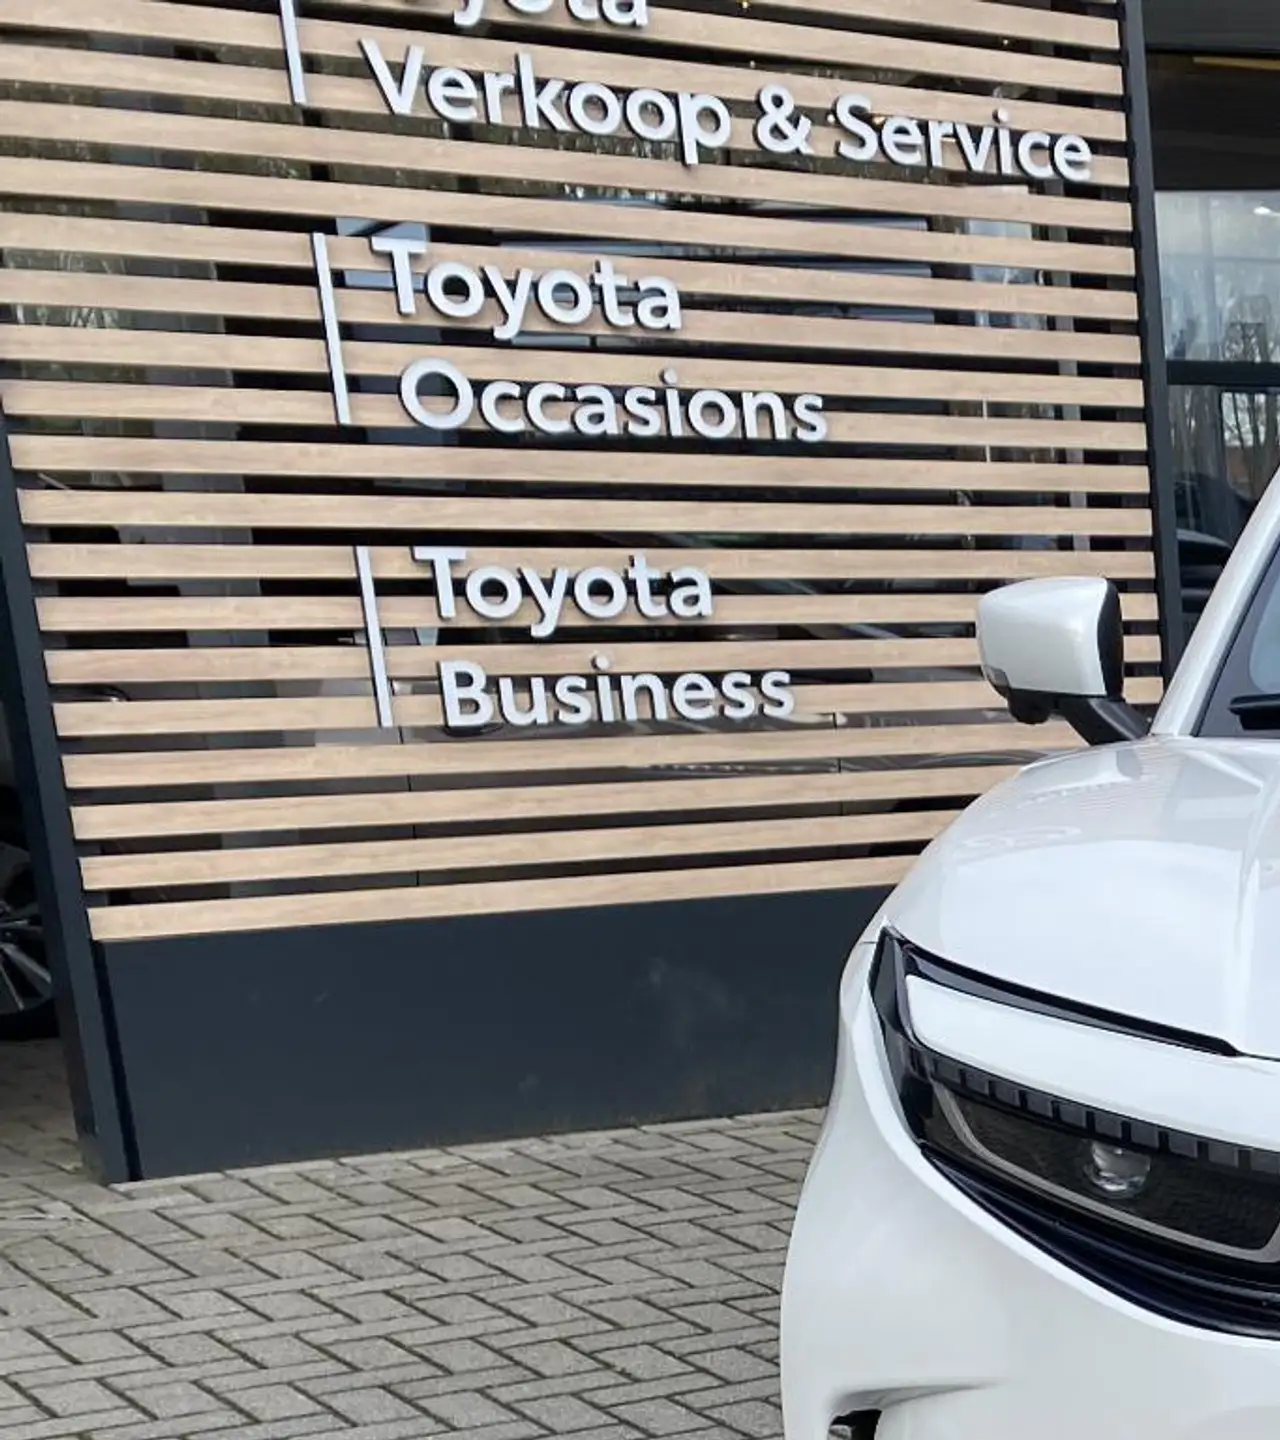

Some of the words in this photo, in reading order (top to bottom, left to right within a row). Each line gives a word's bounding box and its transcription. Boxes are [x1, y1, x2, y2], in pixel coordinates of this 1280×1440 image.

[359, 38, 732, 166] Verkoop
[757, 84, 814, 154] &
[834, 93, 1092, 182] Service
[370, 236, 682, 340] Toyota
[400, 357, 828, 442] Occasions
[412, 546, 713, 638] Toyota
[438, 655, 797, 728] Business
